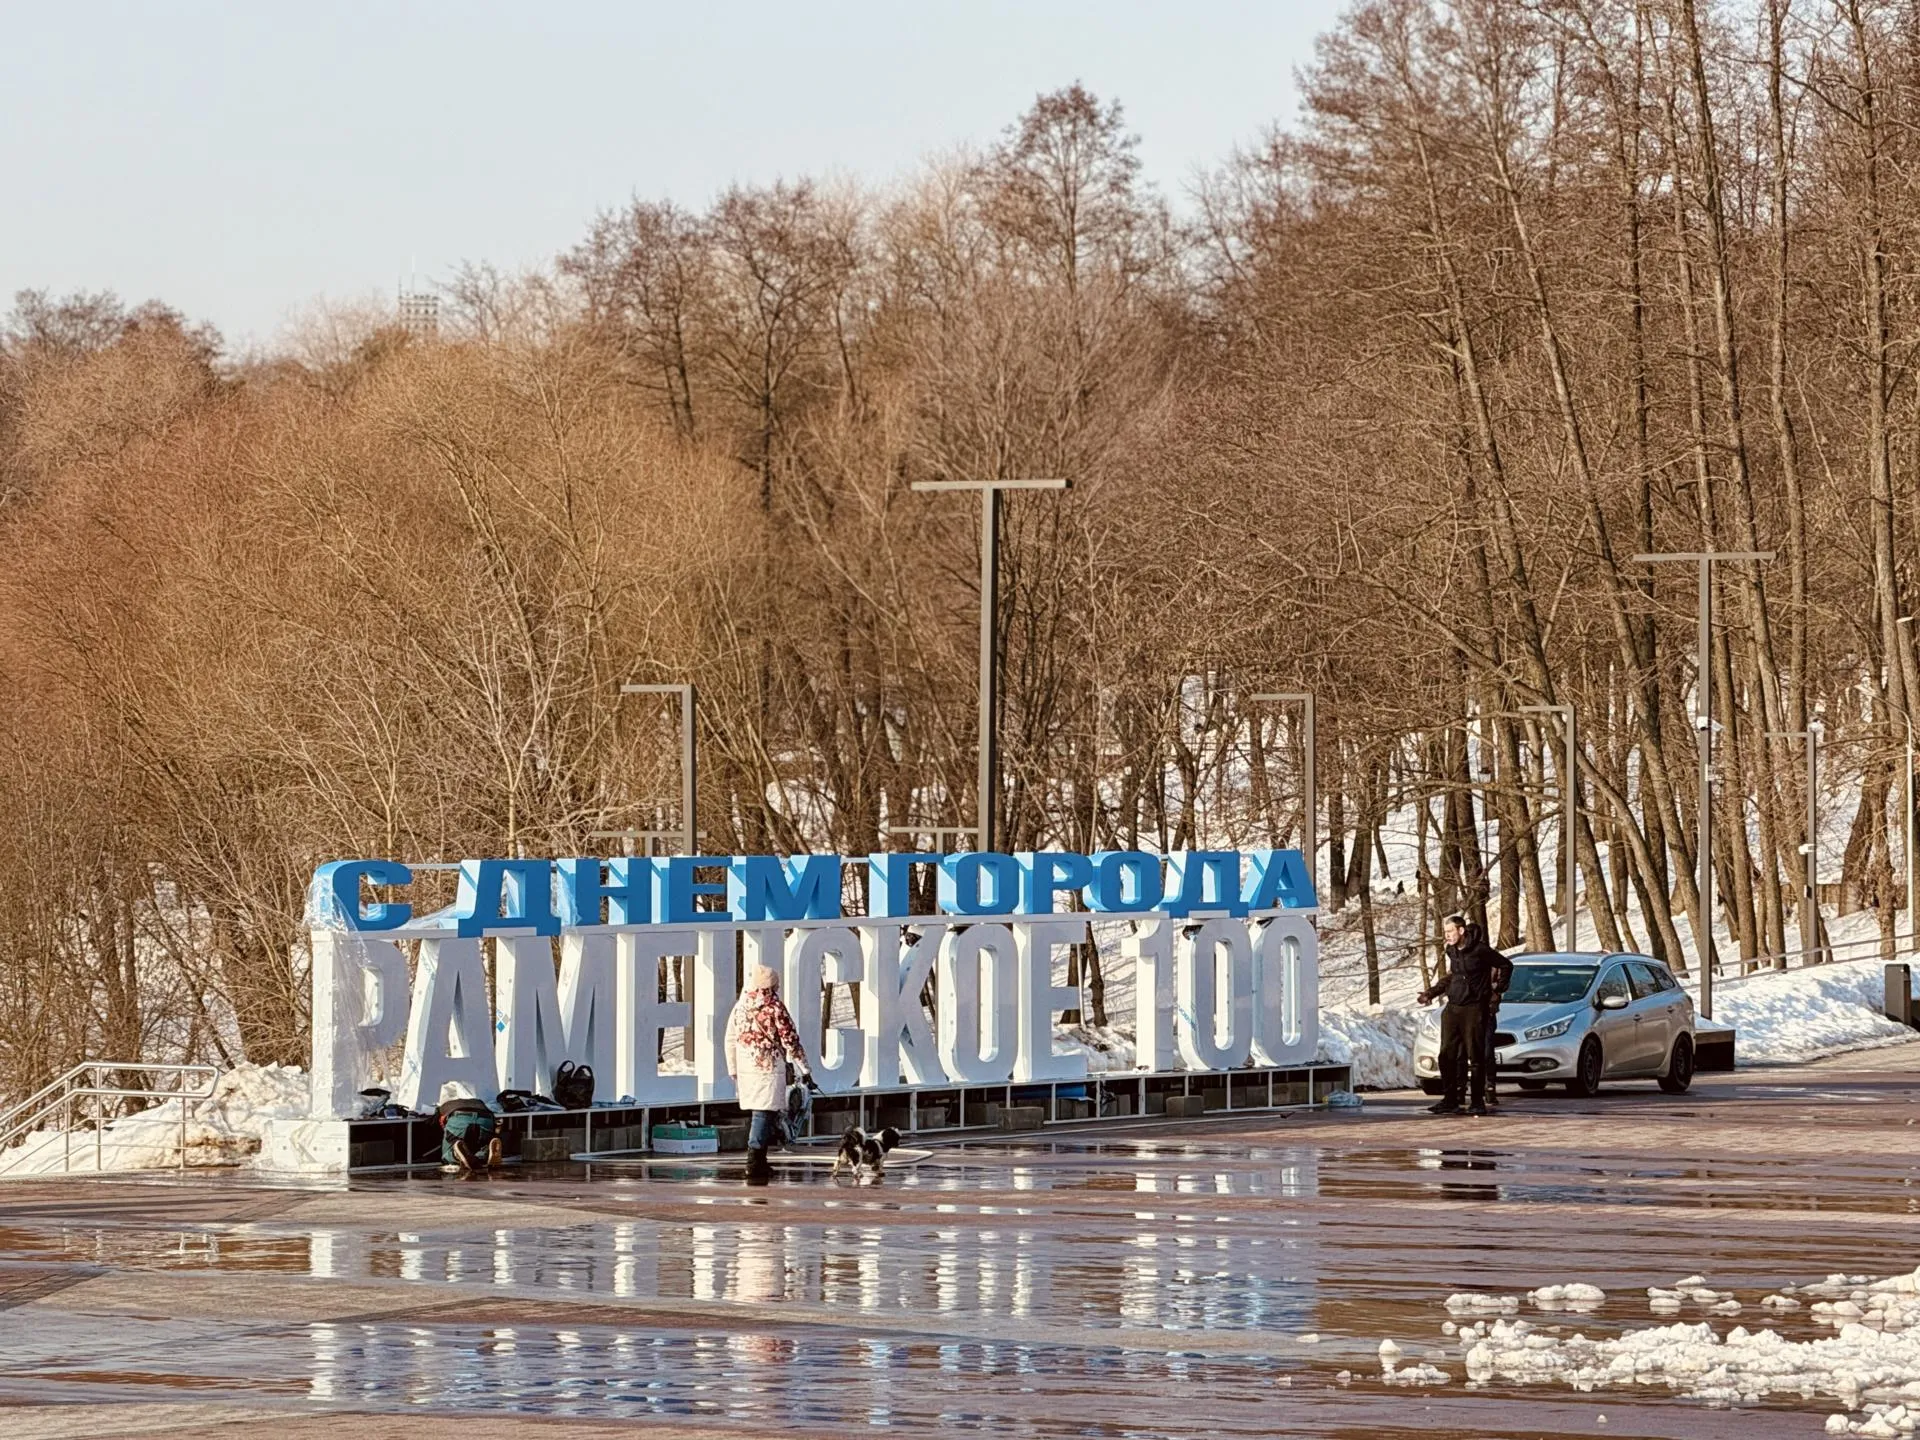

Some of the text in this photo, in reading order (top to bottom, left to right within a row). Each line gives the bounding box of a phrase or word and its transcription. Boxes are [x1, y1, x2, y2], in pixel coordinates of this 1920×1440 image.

[314, 849, 1318, 938] С ДНЕМ ГОРОДА
[1121, 917, 1318, 1073] 100
